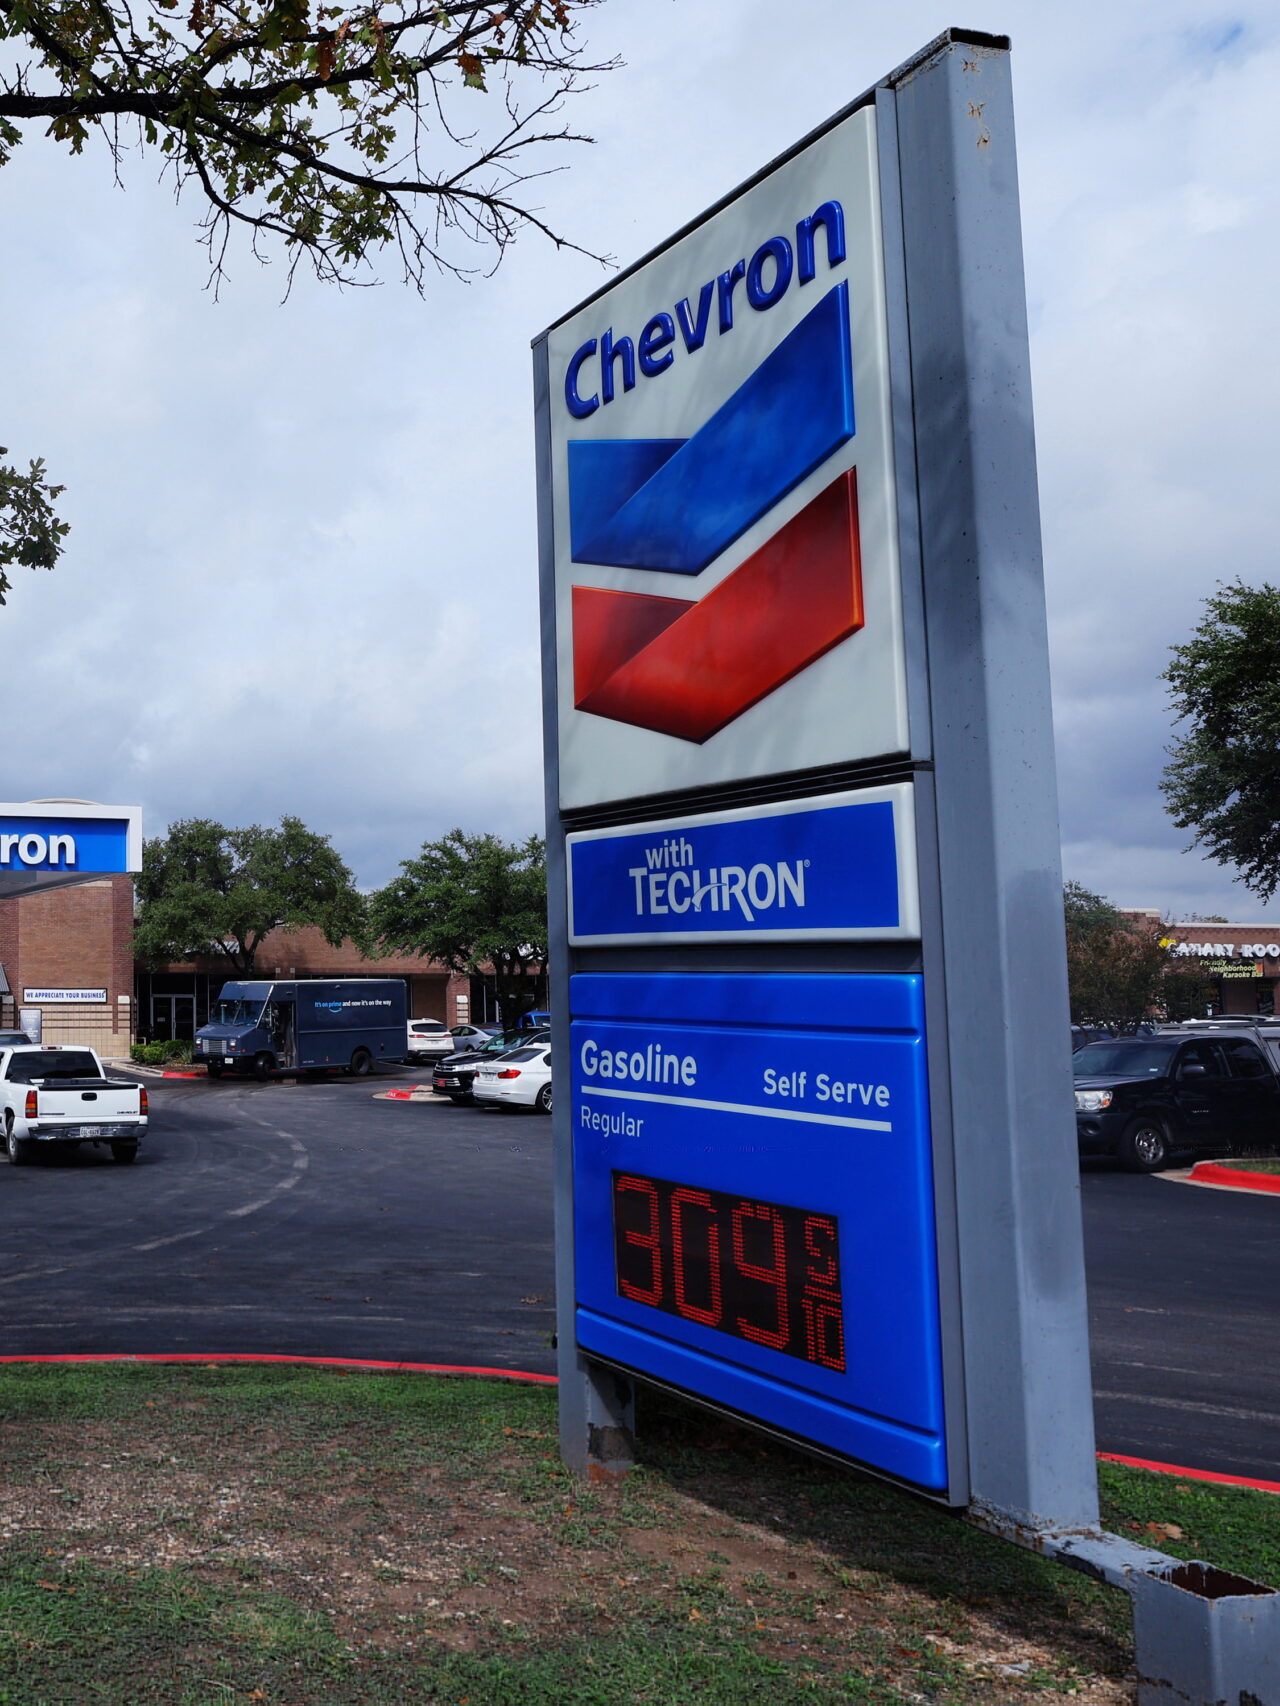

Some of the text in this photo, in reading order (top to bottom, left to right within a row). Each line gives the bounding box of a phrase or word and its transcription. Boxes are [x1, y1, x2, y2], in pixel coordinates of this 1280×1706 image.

[565, 200, 847, 420] Chevron
[645, 837, 694, 870] with
[629, 860, 806, 922] TECHRON
[580, 1039, 697, 1086] Gasoline
[763, 1068, 891, 1107] Self Serve
[580, 1105, 644, 1138] Regular
